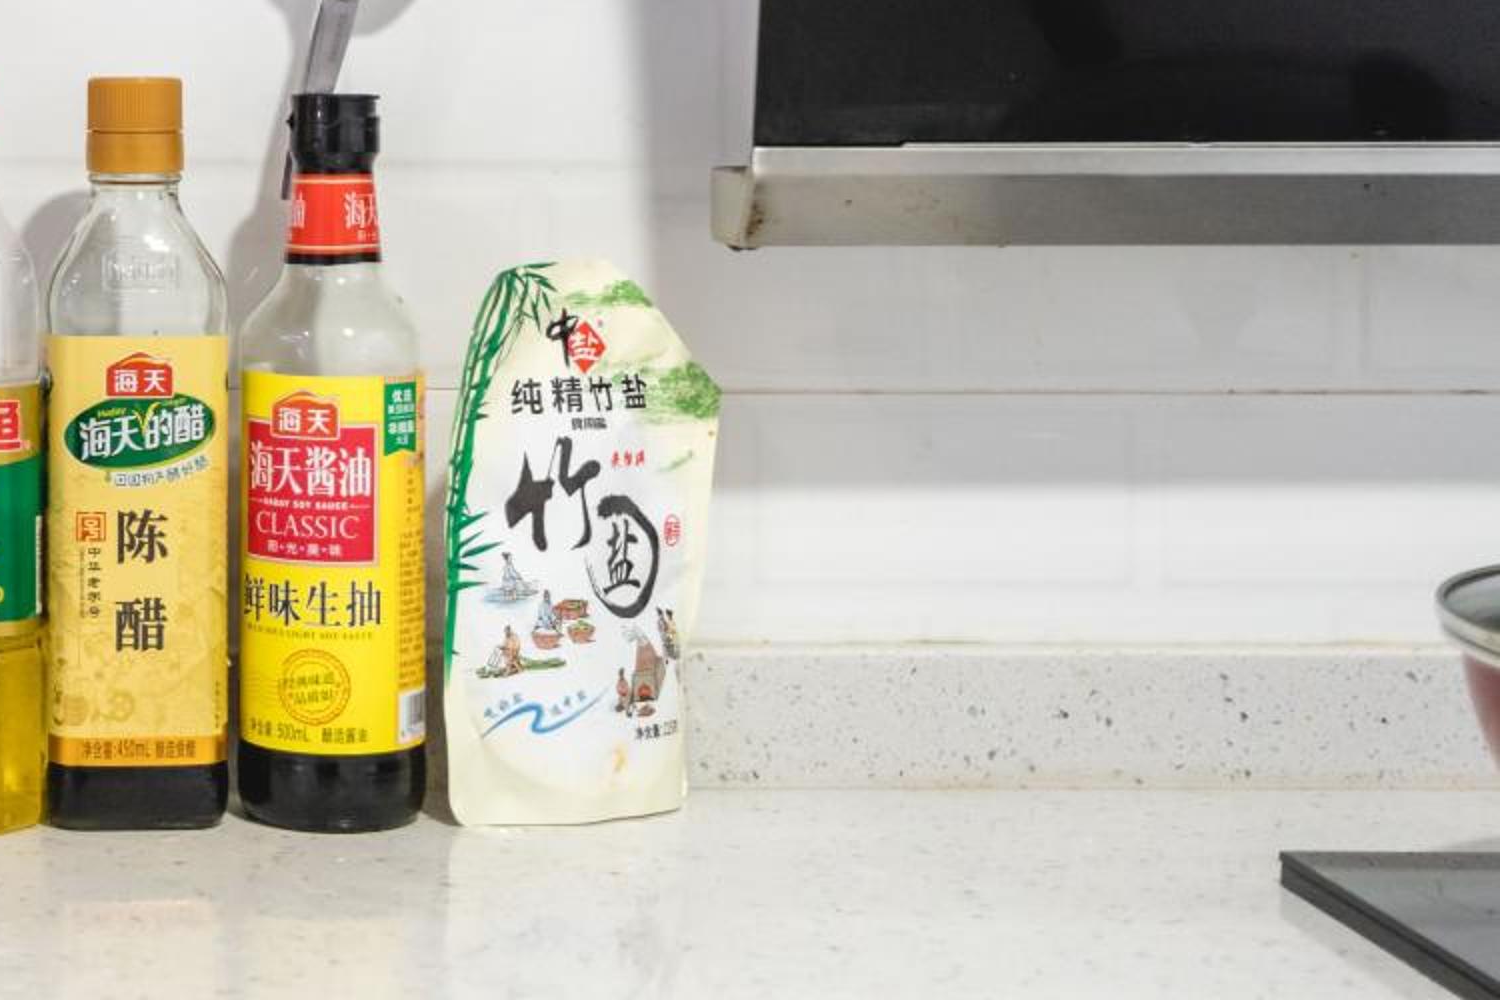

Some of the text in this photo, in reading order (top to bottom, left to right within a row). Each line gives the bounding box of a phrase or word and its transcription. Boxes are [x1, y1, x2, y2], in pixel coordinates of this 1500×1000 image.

[114, 369, 165, 393] 海天
[511, 374, 647, 414] 纯精竹盐
[79, 404, 205, 460] 海天的醋
[277, 407, 331, 434] 海天
[250, 440, 371, 497] 海天酱油
[256, 510, 360, 539] CLASSIC
[243, 573, 381, 627] 鲜味生抽
